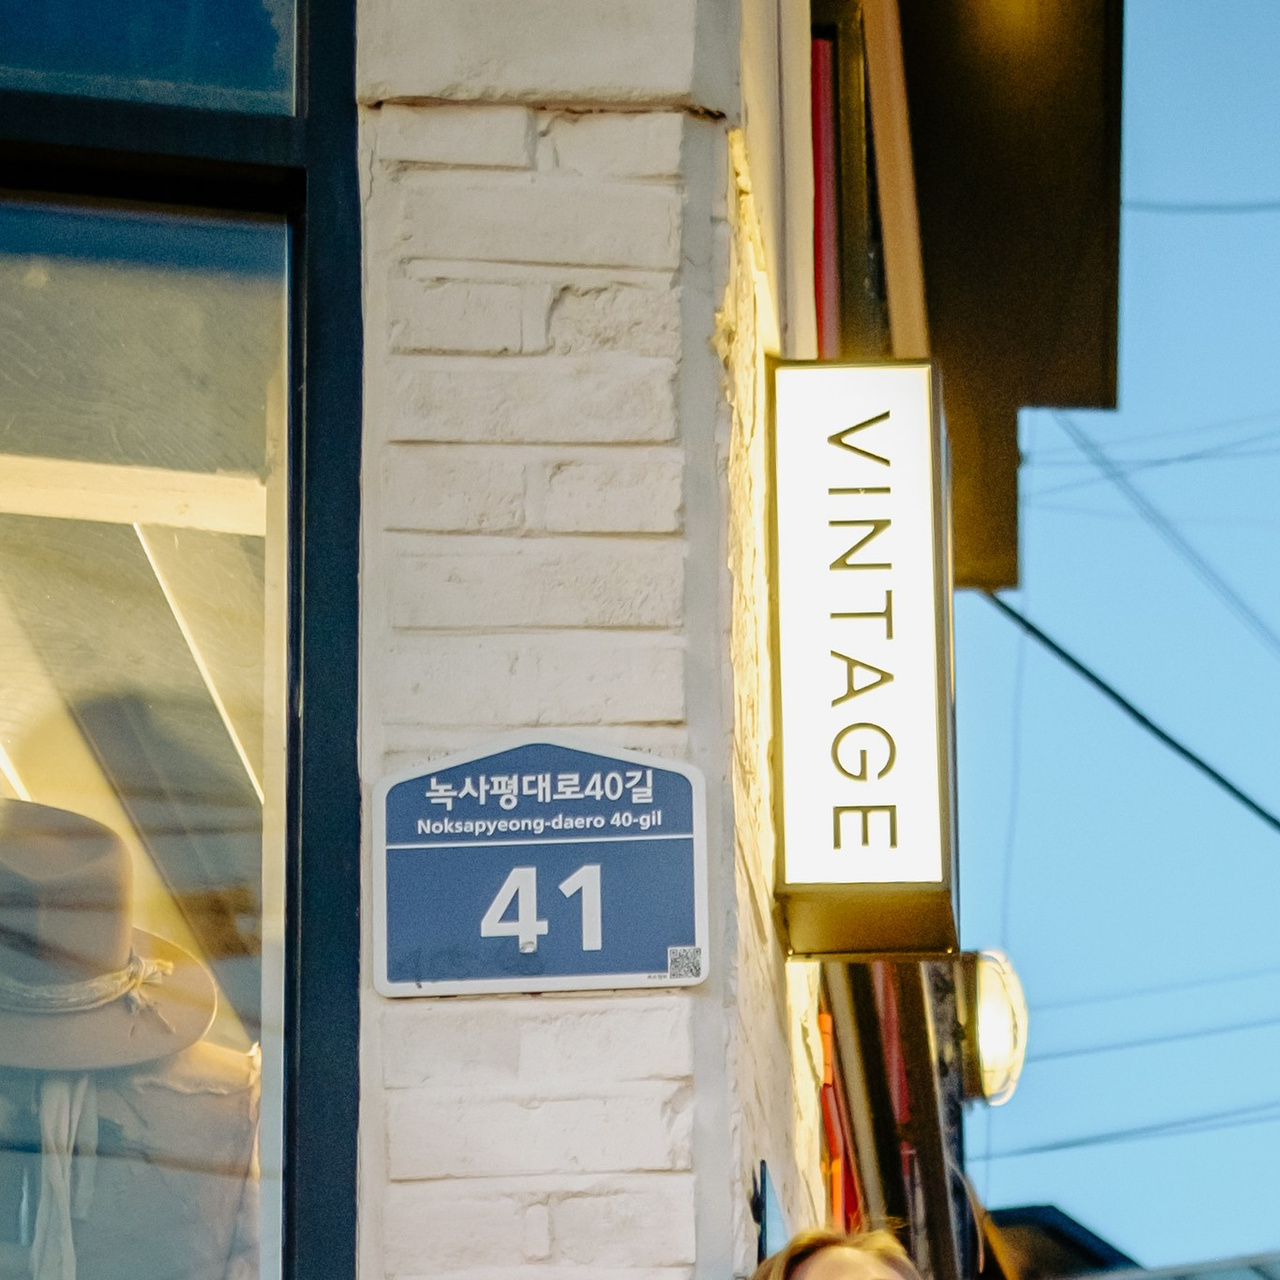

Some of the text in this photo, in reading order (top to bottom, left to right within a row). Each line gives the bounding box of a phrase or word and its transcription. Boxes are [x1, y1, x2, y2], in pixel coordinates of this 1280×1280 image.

[827, 410, 898, 850] VINTAGE
[425, 769, 654, 811] 녹사평대로40길
[417, 810, 662, 836] Noksapyeong-daero 40-gil
[481, 865, 602, 954] 41
